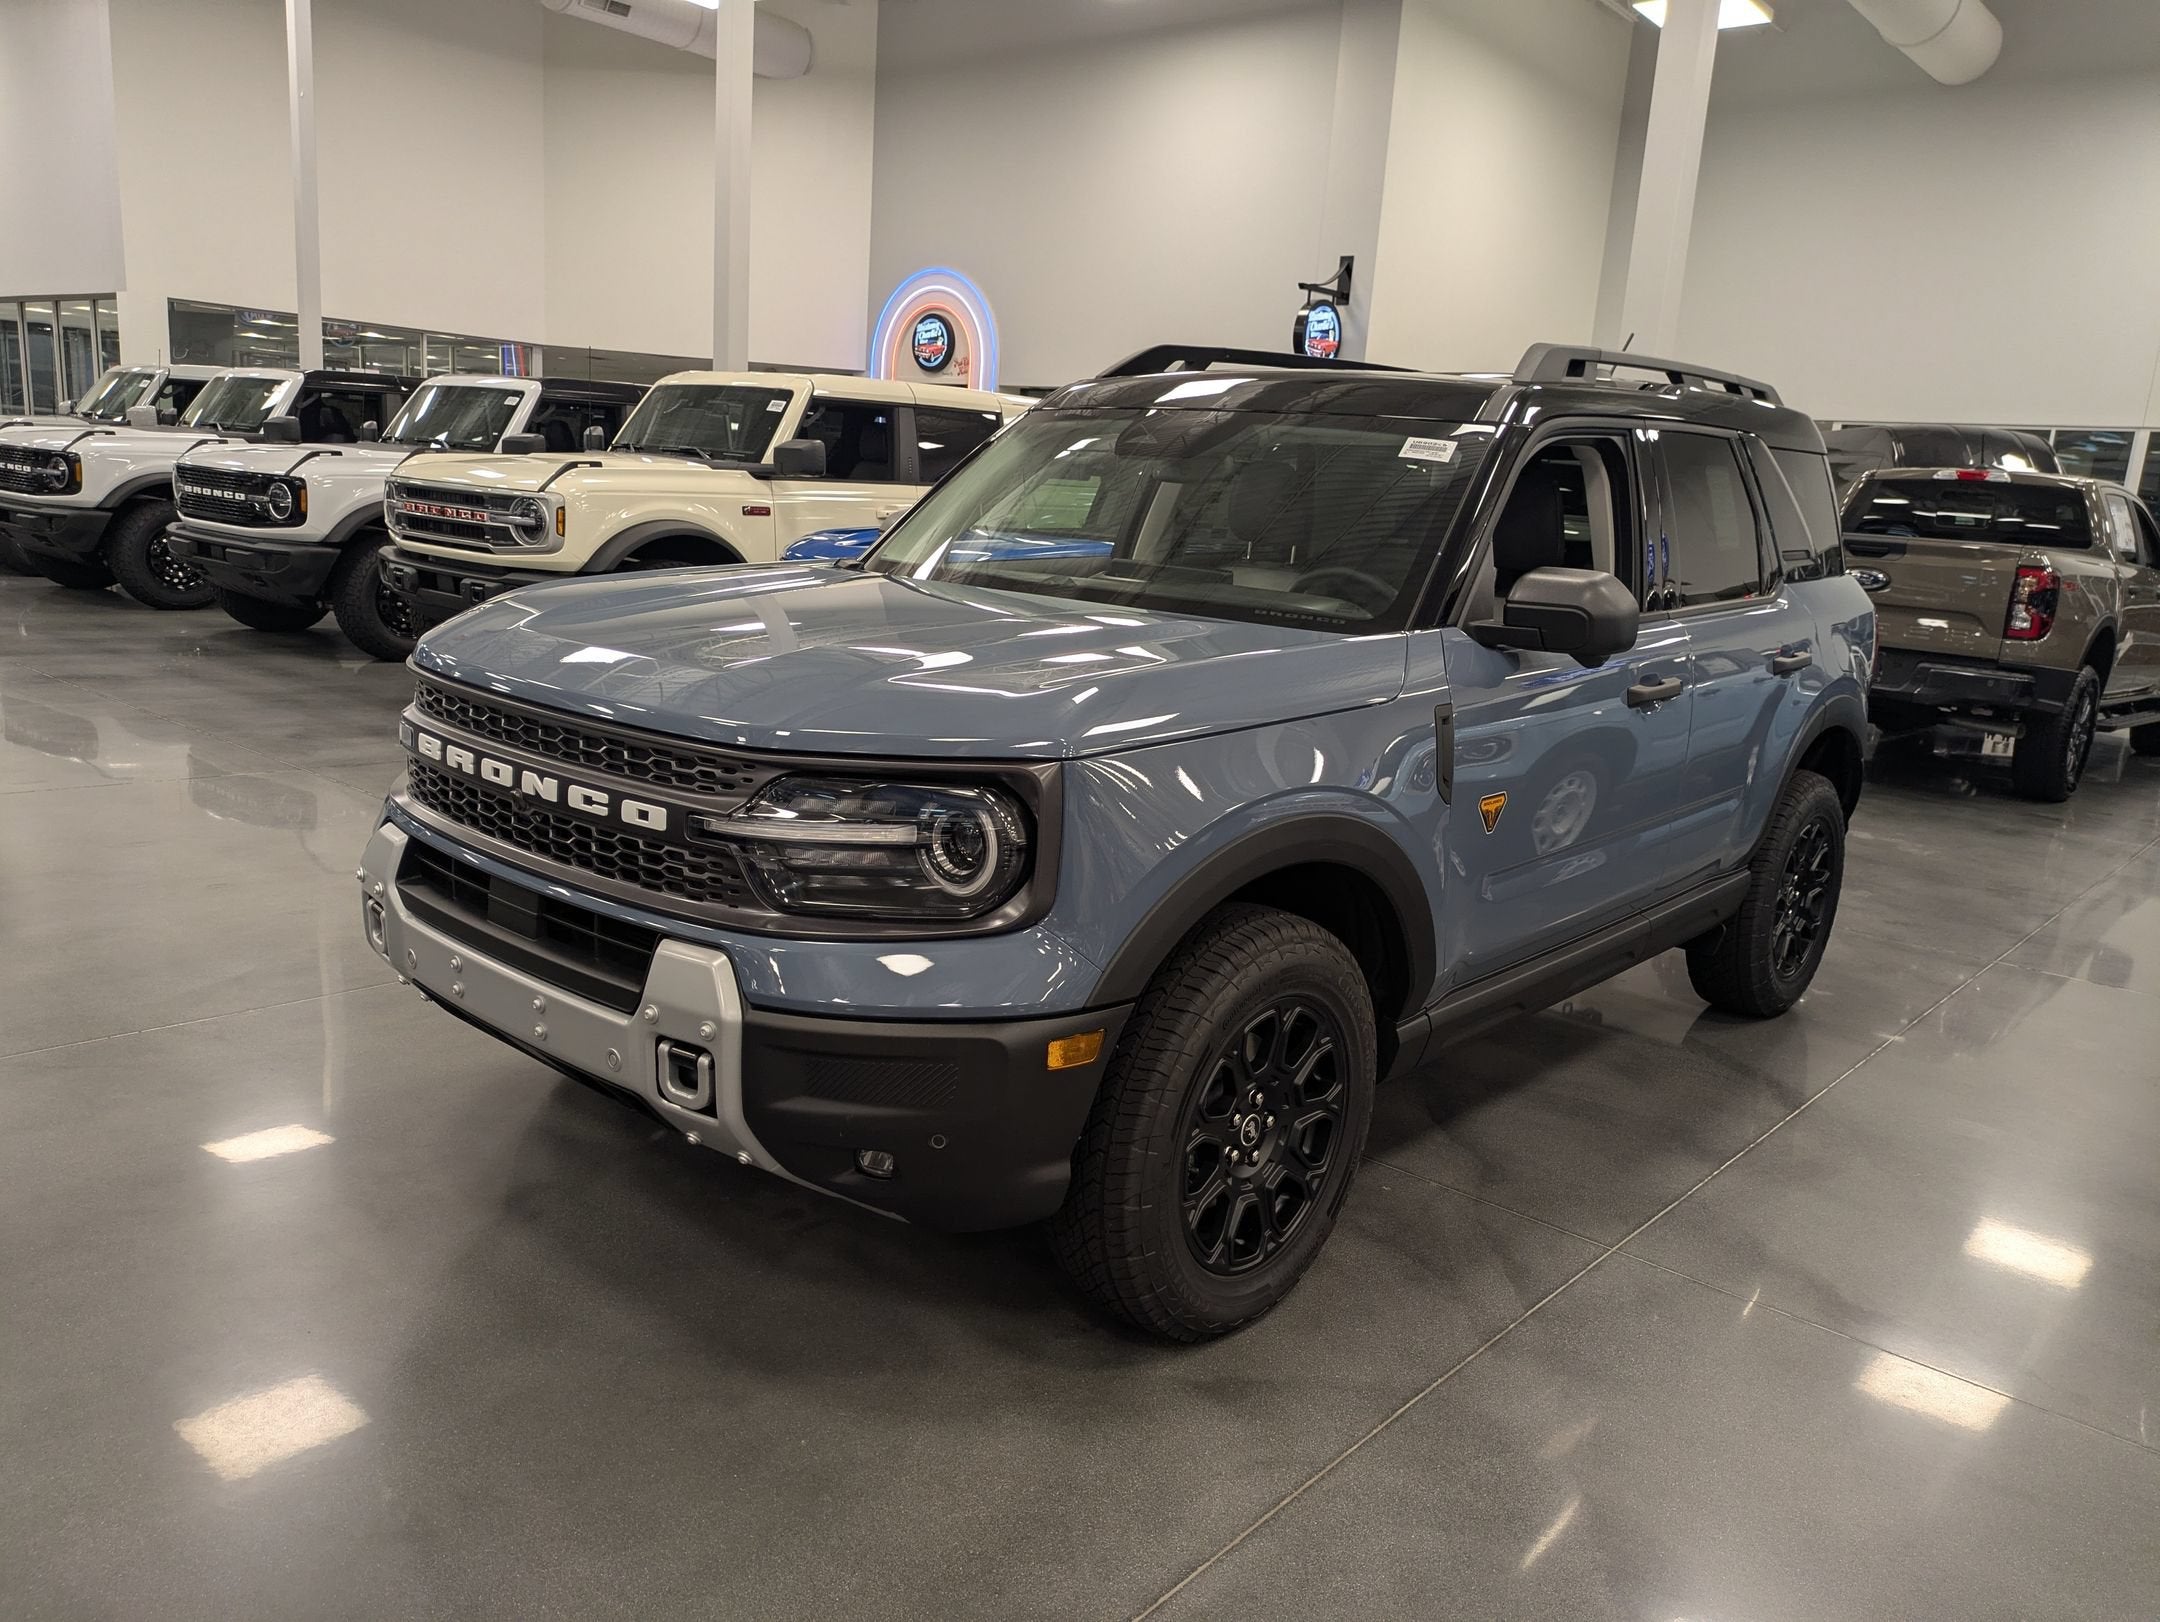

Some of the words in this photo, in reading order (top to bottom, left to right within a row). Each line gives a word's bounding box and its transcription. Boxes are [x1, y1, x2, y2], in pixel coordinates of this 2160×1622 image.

[184, 485, 246, 501] BRONCO
[404, 502, 488, 522] BRONCO
[418, 732, 667, 832] BRONCO
